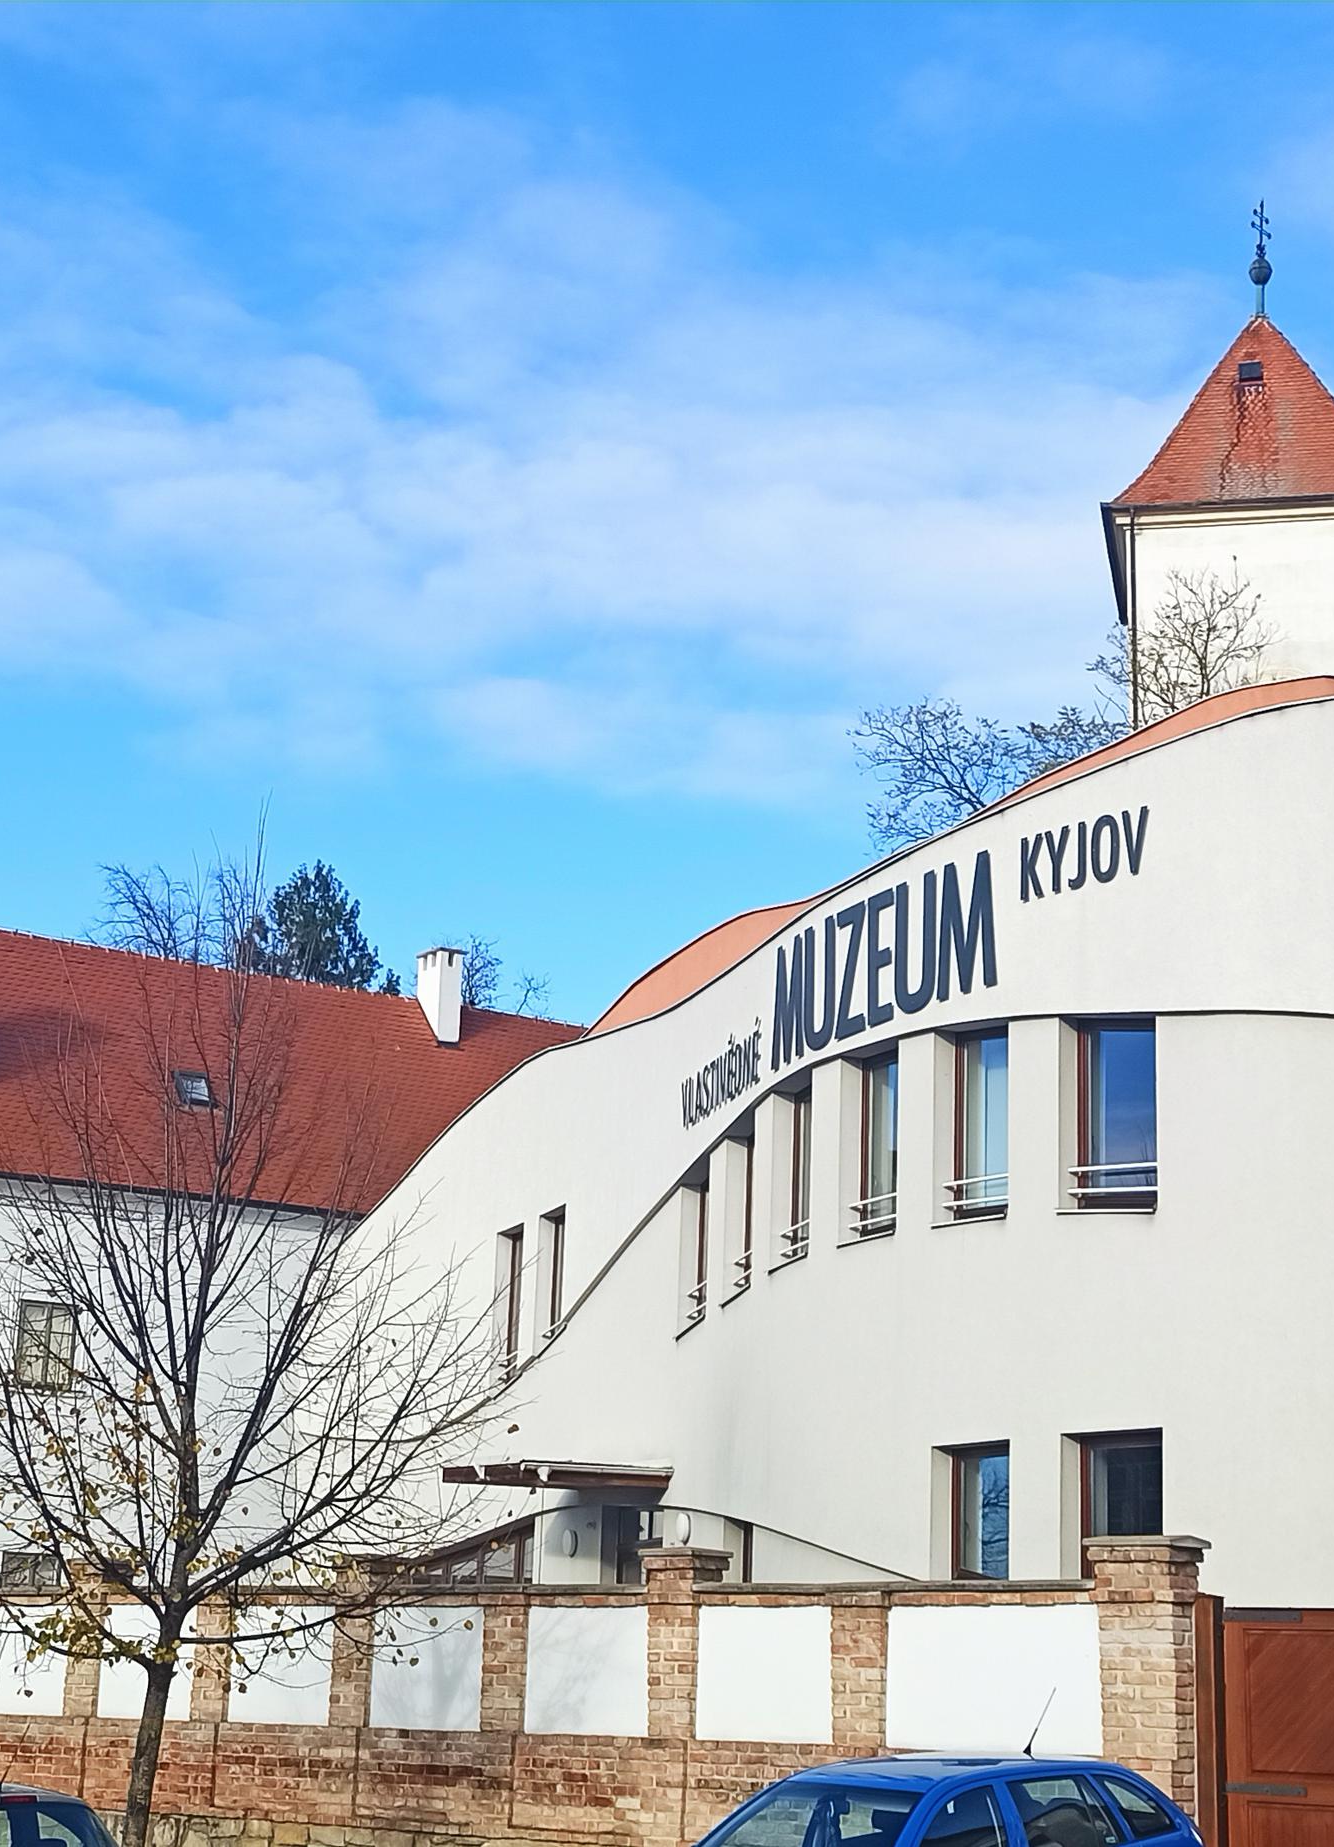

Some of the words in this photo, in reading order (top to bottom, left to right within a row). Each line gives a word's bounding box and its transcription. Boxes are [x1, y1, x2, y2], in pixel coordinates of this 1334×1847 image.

[1020, 806, 1149, 903] KYJOV
[681, 1016, 762, 1131] VLASTIVĚDNÉ
[770, 850, 998, 1073] MUZEUM
